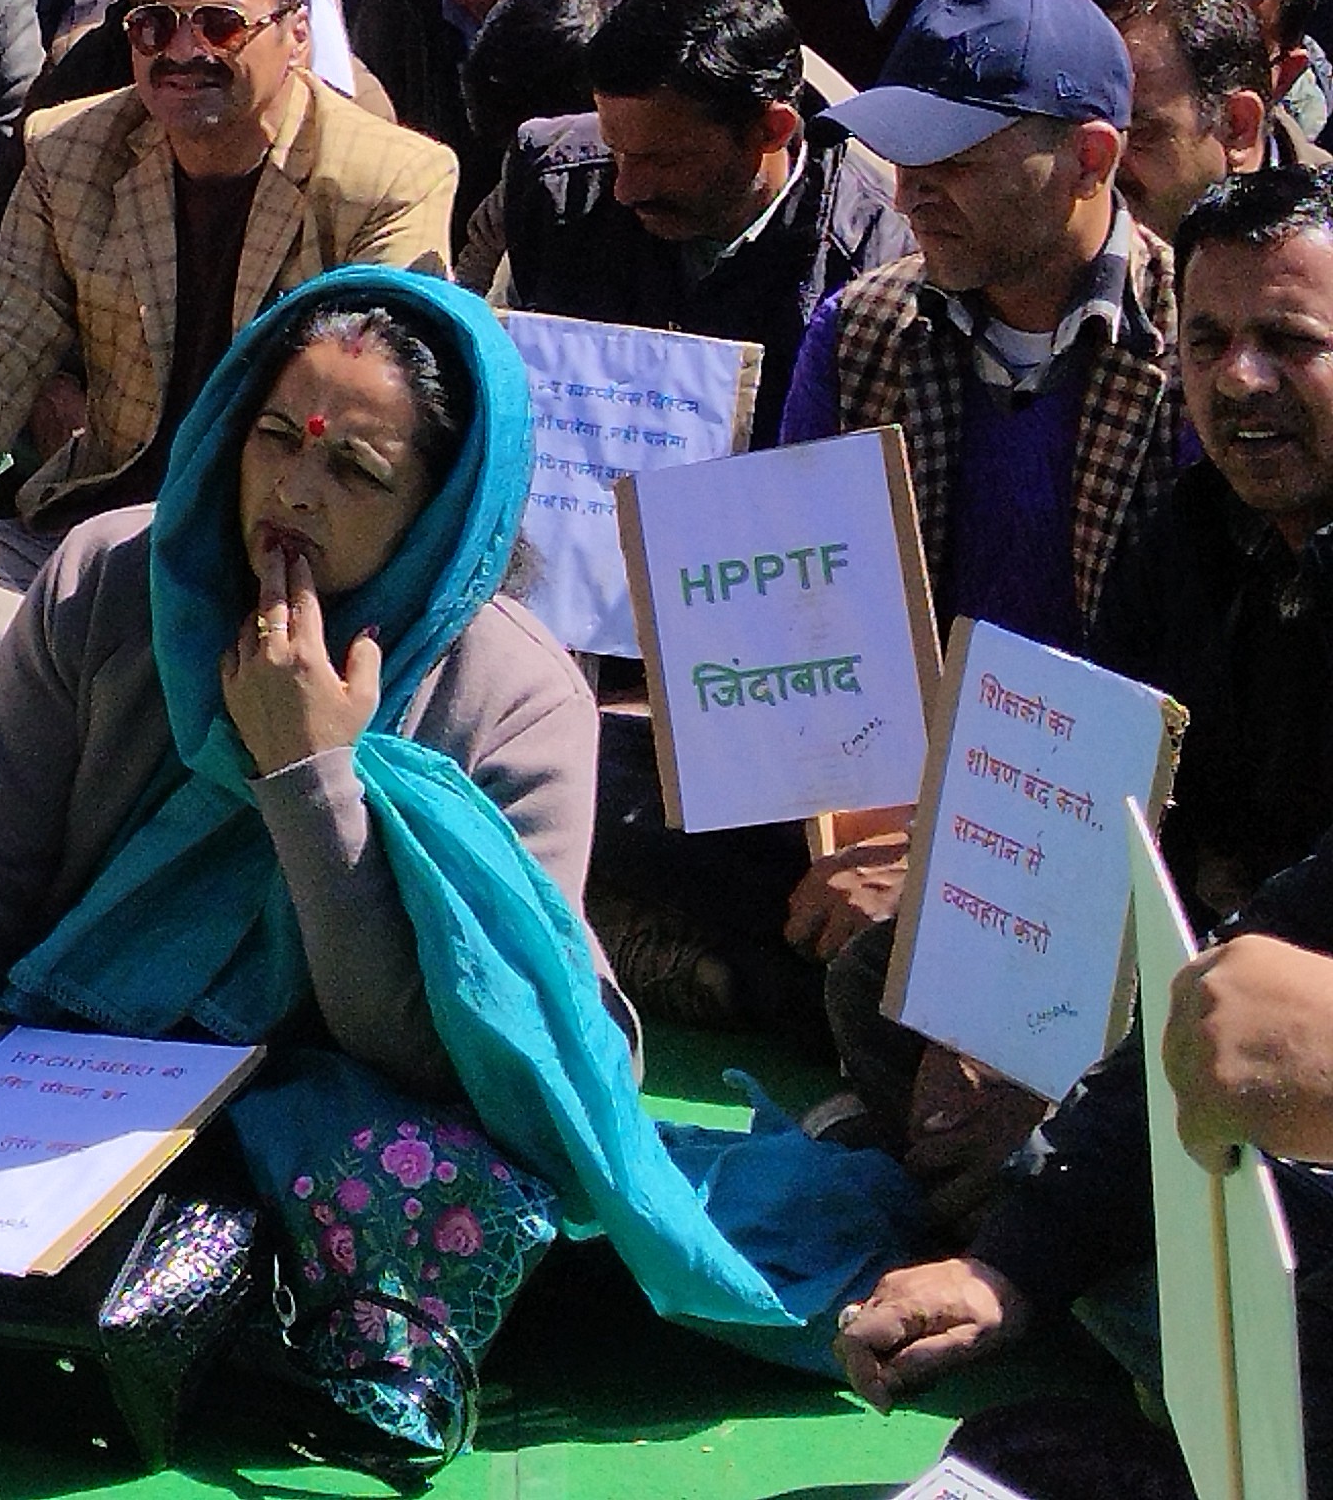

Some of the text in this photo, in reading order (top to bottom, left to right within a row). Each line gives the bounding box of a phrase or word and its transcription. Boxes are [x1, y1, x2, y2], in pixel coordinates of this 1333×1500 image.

[679, 542, 850, 607] HPPTF
[692, 654, 863, 713] जिंदाबाद
[1048, 709, 1076, 741] का
[1023, 767, 1054, 809] बंद
[1014, 915, 1052, 955] करो
